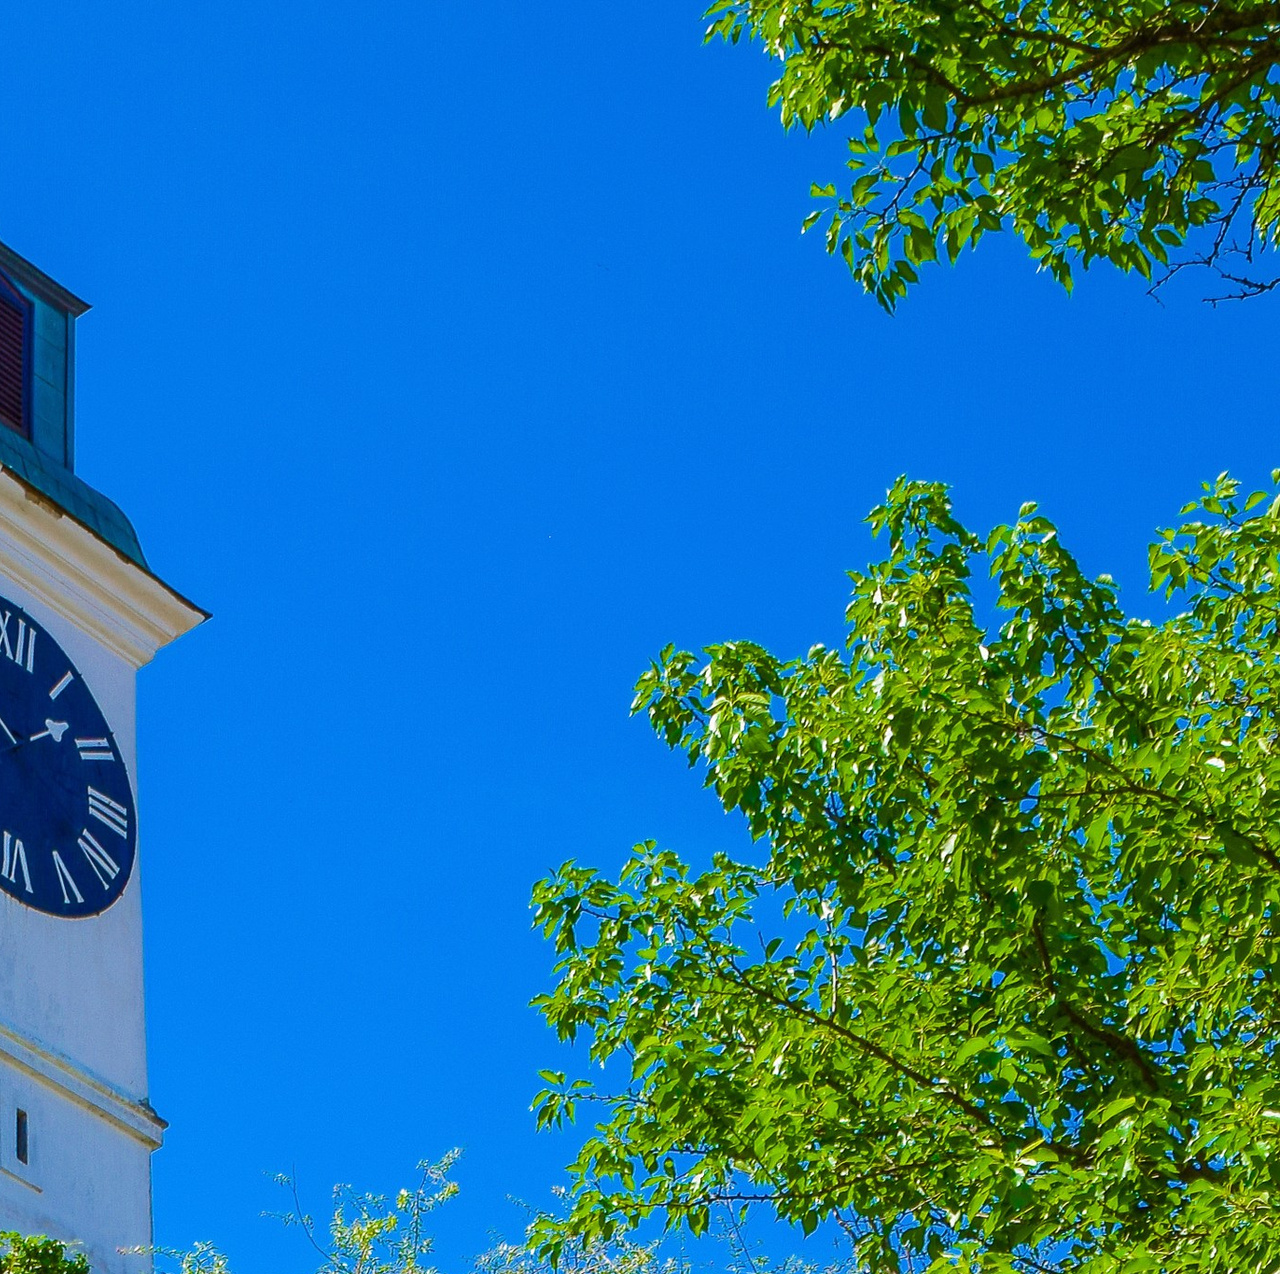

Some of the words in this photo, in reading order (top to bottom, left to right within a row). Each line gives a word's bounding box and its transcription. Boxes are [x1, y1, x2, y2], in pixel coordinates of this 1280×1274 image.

[74, 737, 116, 762] II
[88, 785, 128, 840] III
[1, 830, 34, 894] VI
[53, 850, 85, 904] V
[77, 827, 121, 890] IV
